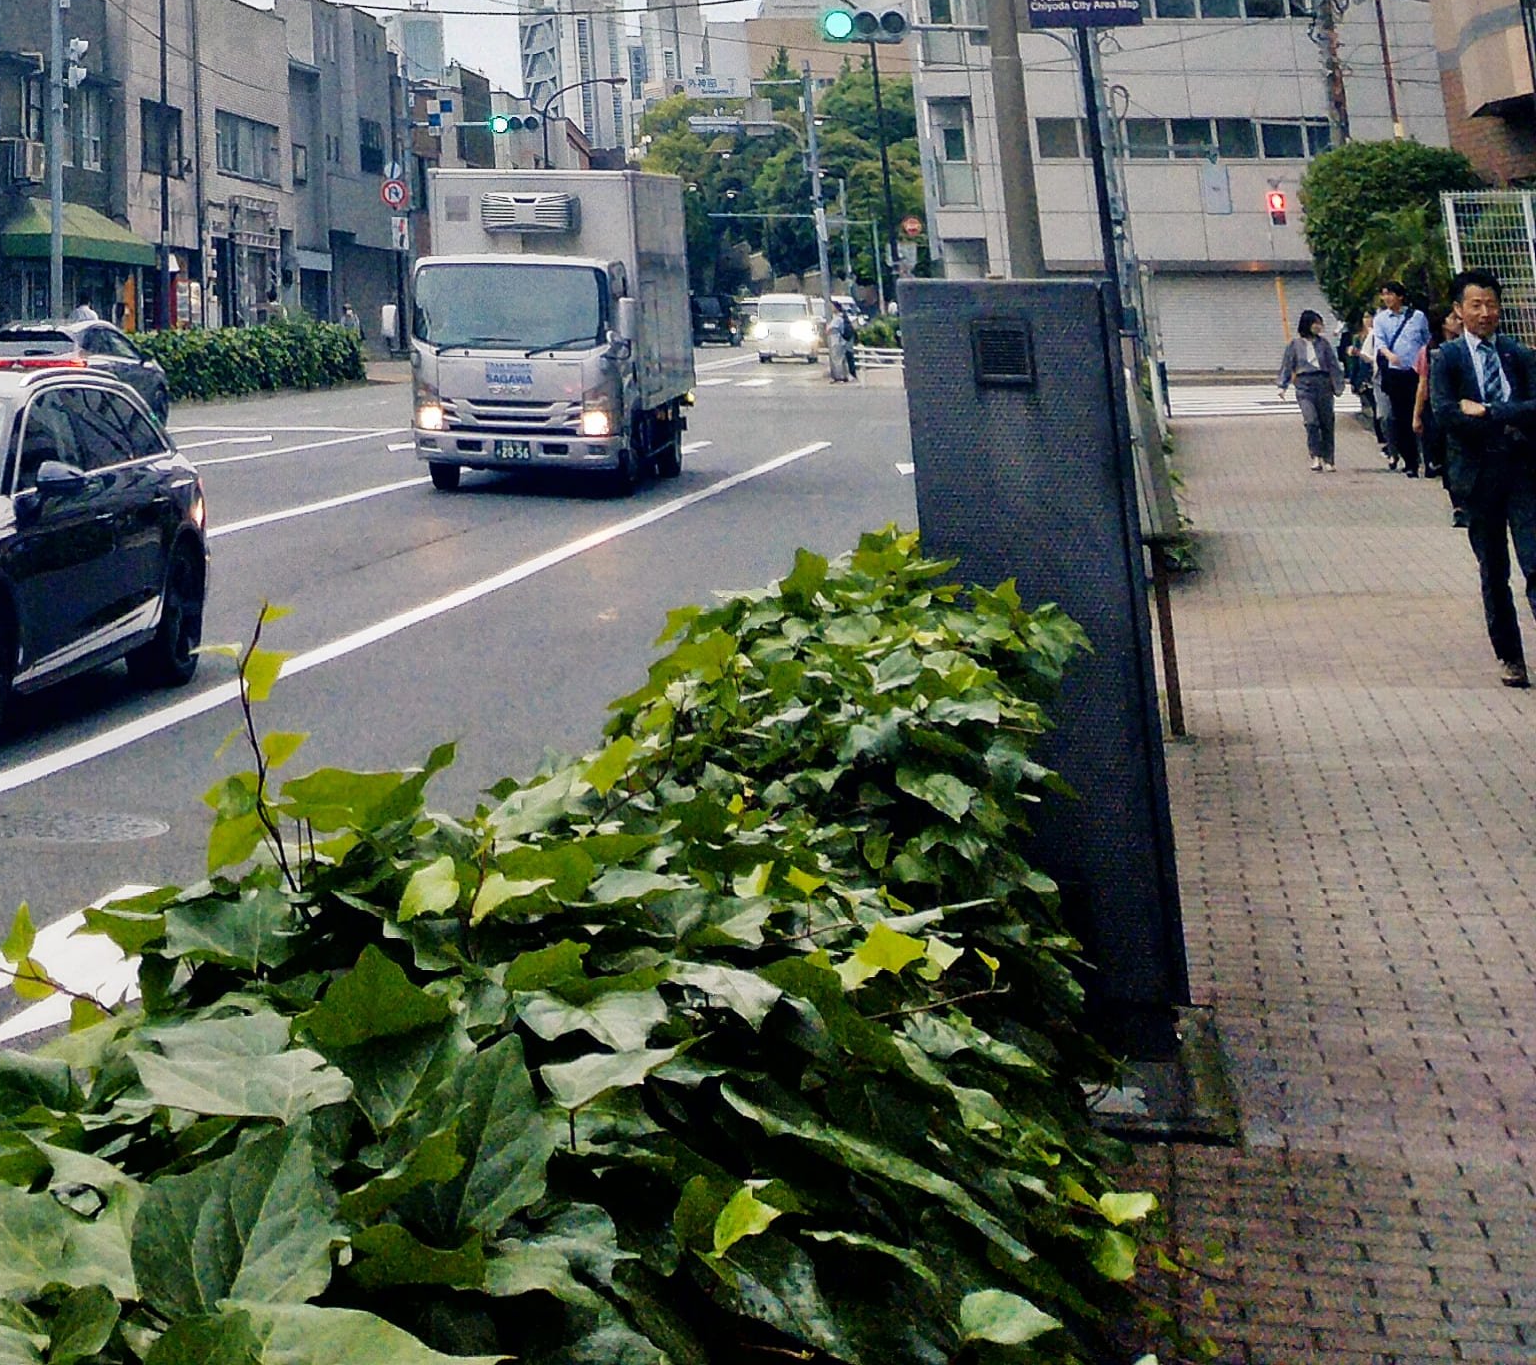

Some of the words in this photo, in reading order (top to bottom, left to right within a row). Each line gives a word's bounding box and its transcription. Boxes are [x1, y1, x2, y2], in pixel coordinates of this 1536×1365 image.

[1030, 2, 1070, 13] Chiyoda
[1072, 1, 1092, 12] City
[1093, 0, 1116, 10] Area
[1118, 0, 1140, 10] Map
